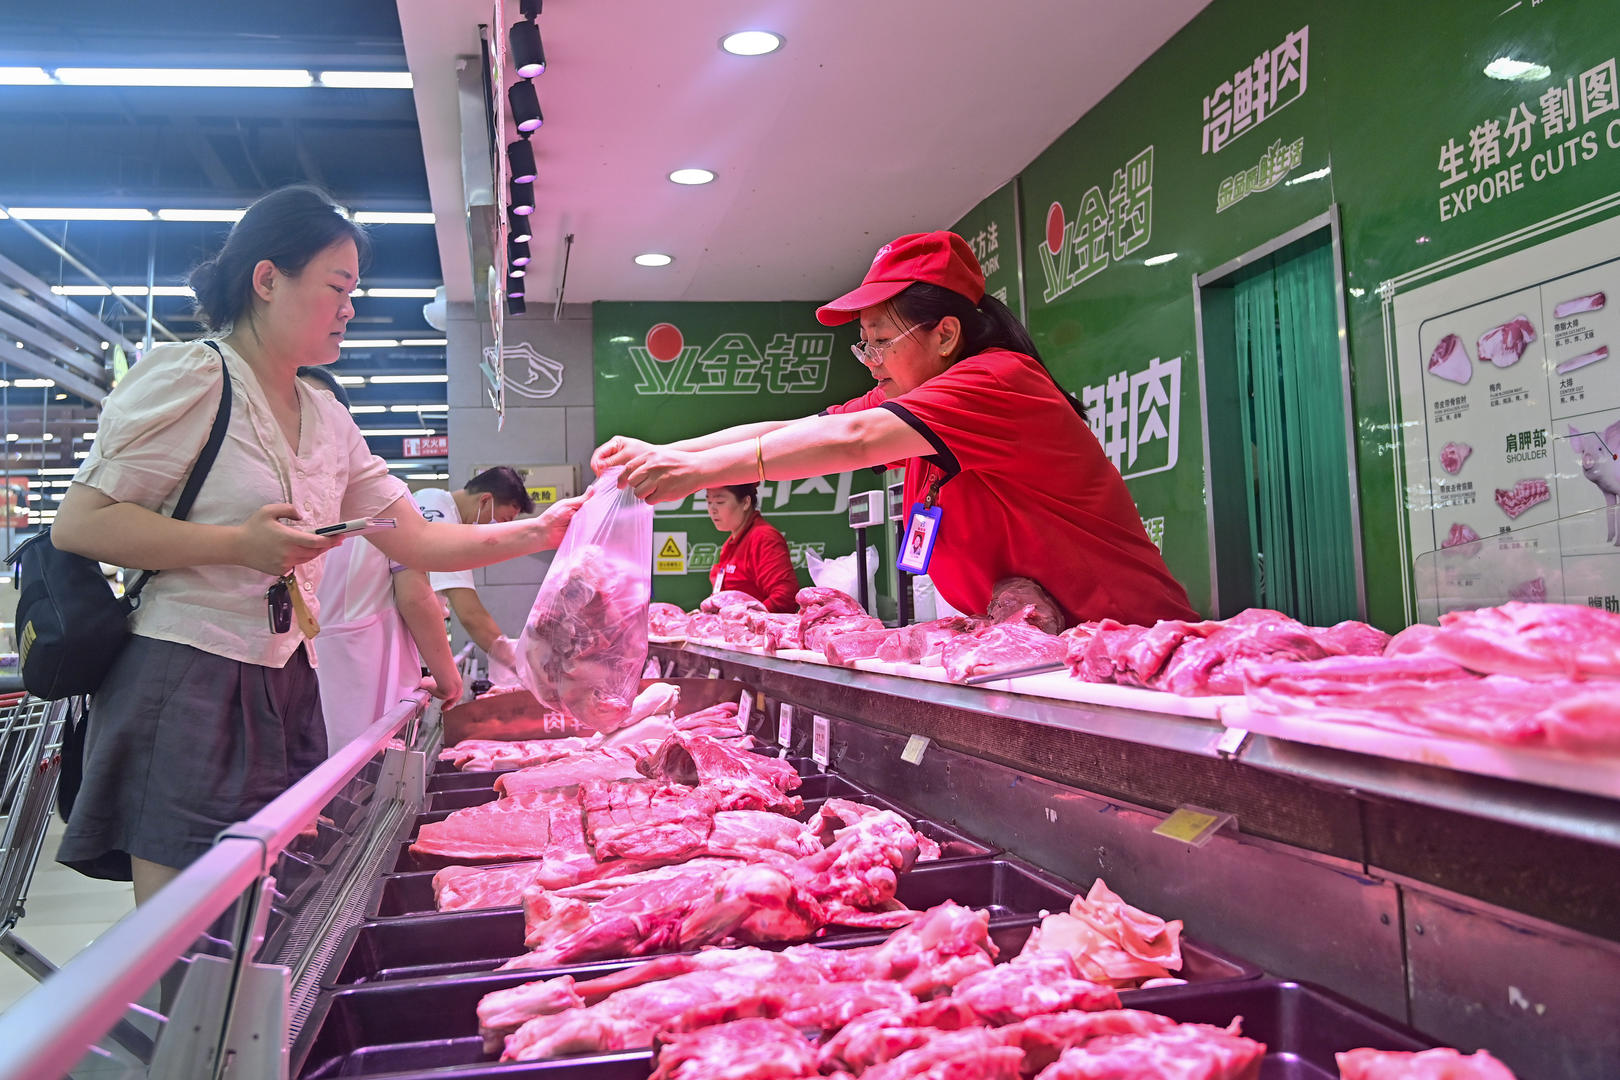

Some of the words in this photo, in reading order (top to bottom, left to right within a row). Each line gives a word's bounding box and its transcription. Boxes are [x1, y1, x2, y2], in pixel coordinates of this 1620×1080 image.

[1202, 24, 1309, 155] 冷鲜肉
[1438, 58, 1620, 189] 生猪分割图
[1074, 145, 1154, 287] 金锣
[1439, 163, 1525, 222] EXPORE
[1530, 132, 1598, 182] CUTS
[697, 333, 834, 394] 金锣
[1073, 356, 1181, 480] 鲜肉
[1506, 428, 1547, 453] 肩胛部
[1506, 449, 1548, 464] SHOULDER
